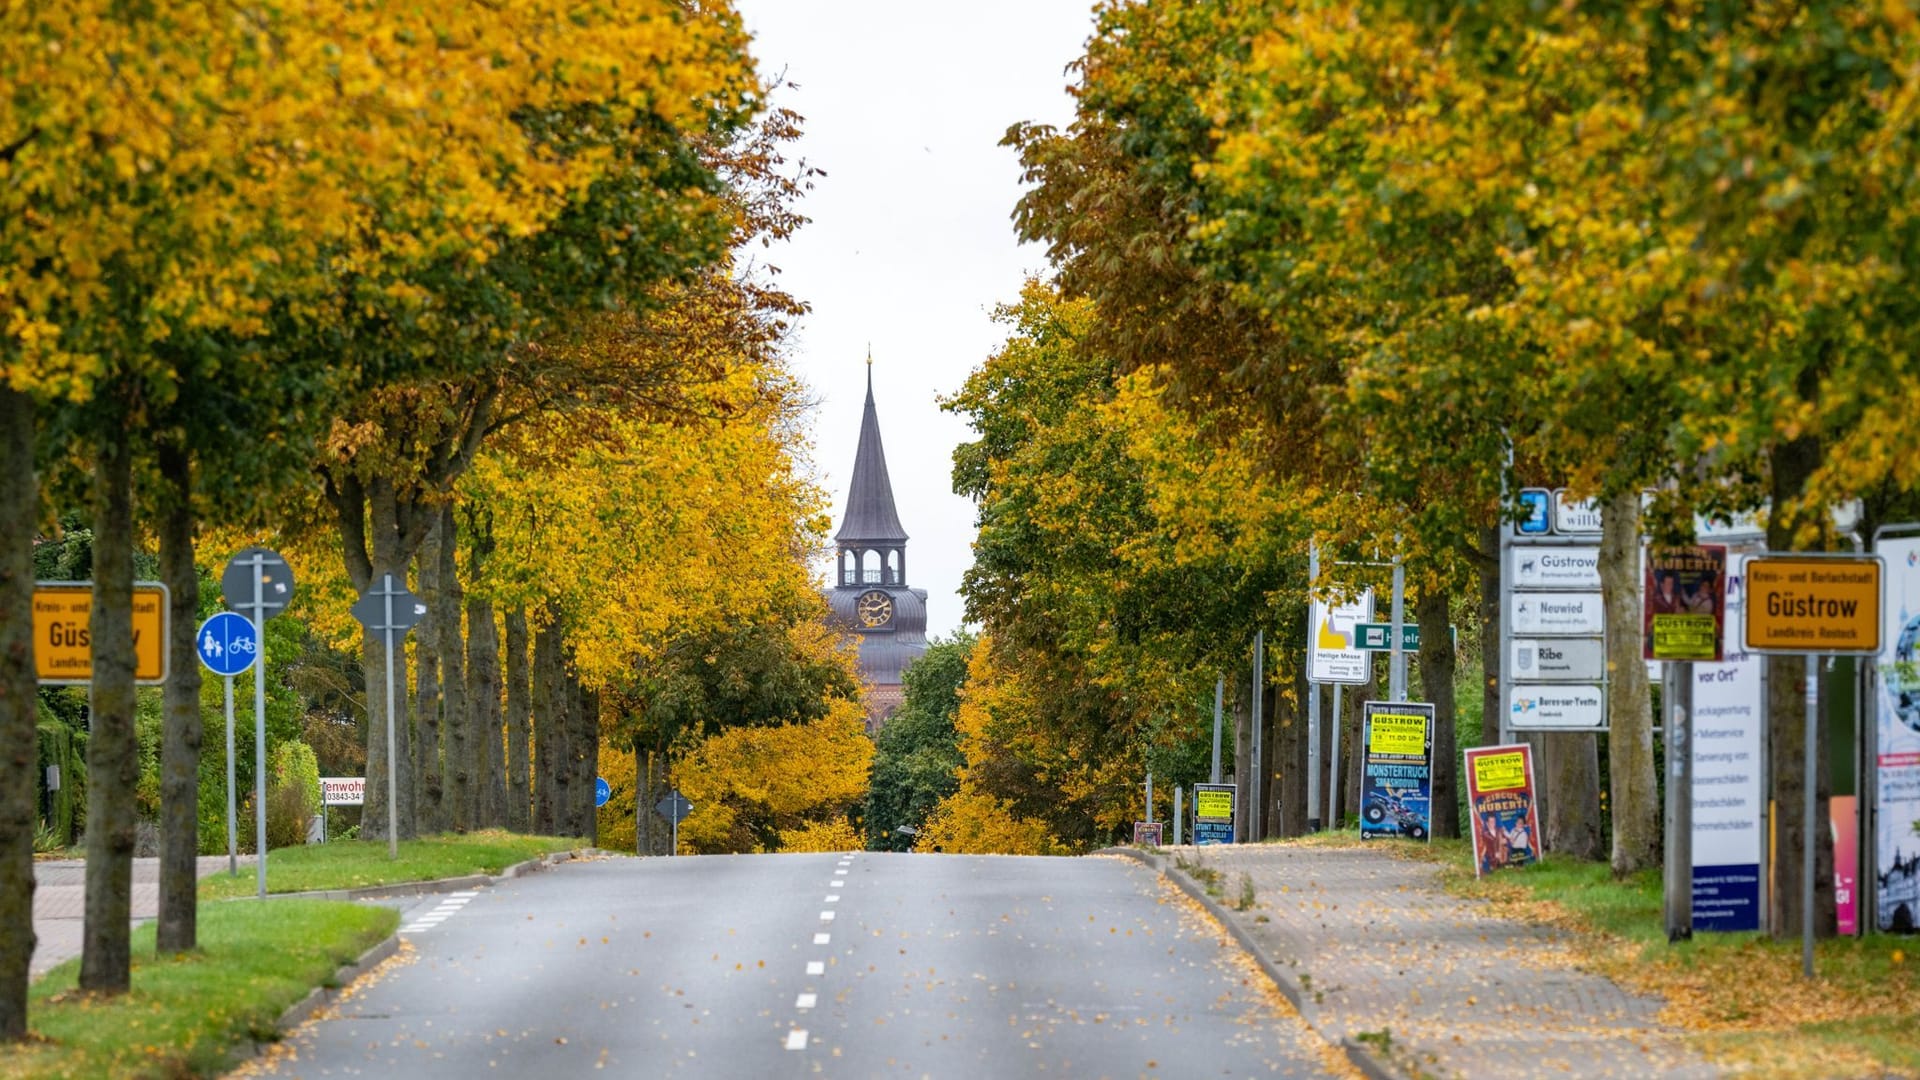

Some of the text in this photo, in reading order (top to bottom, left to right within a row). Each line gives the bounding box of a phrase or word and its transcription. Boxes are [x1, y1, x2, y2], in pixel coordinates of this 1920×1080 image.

[1567, 513, 1602, 527] willk
[1541, 555, 1596, 567] Güstrow
[1789, 572, 1807, 583] und
[70, 602, 90, 613] und
[1540, 601, 1583, 614] Neuwied
[1767, 591, 1858, 619] Güstrow
[1766, 626, 1857, 639] Landkreis Rostock
[1317, 652, 1361, 661] Heilige Messe
[1538, 647, 1563, 660] Ribe
[1698, 672, 1716, 682] vor
[1367, 764, 1428, 778] MONSTERTRUCK
[1478, 800, 1528, 812] HUBERTI
